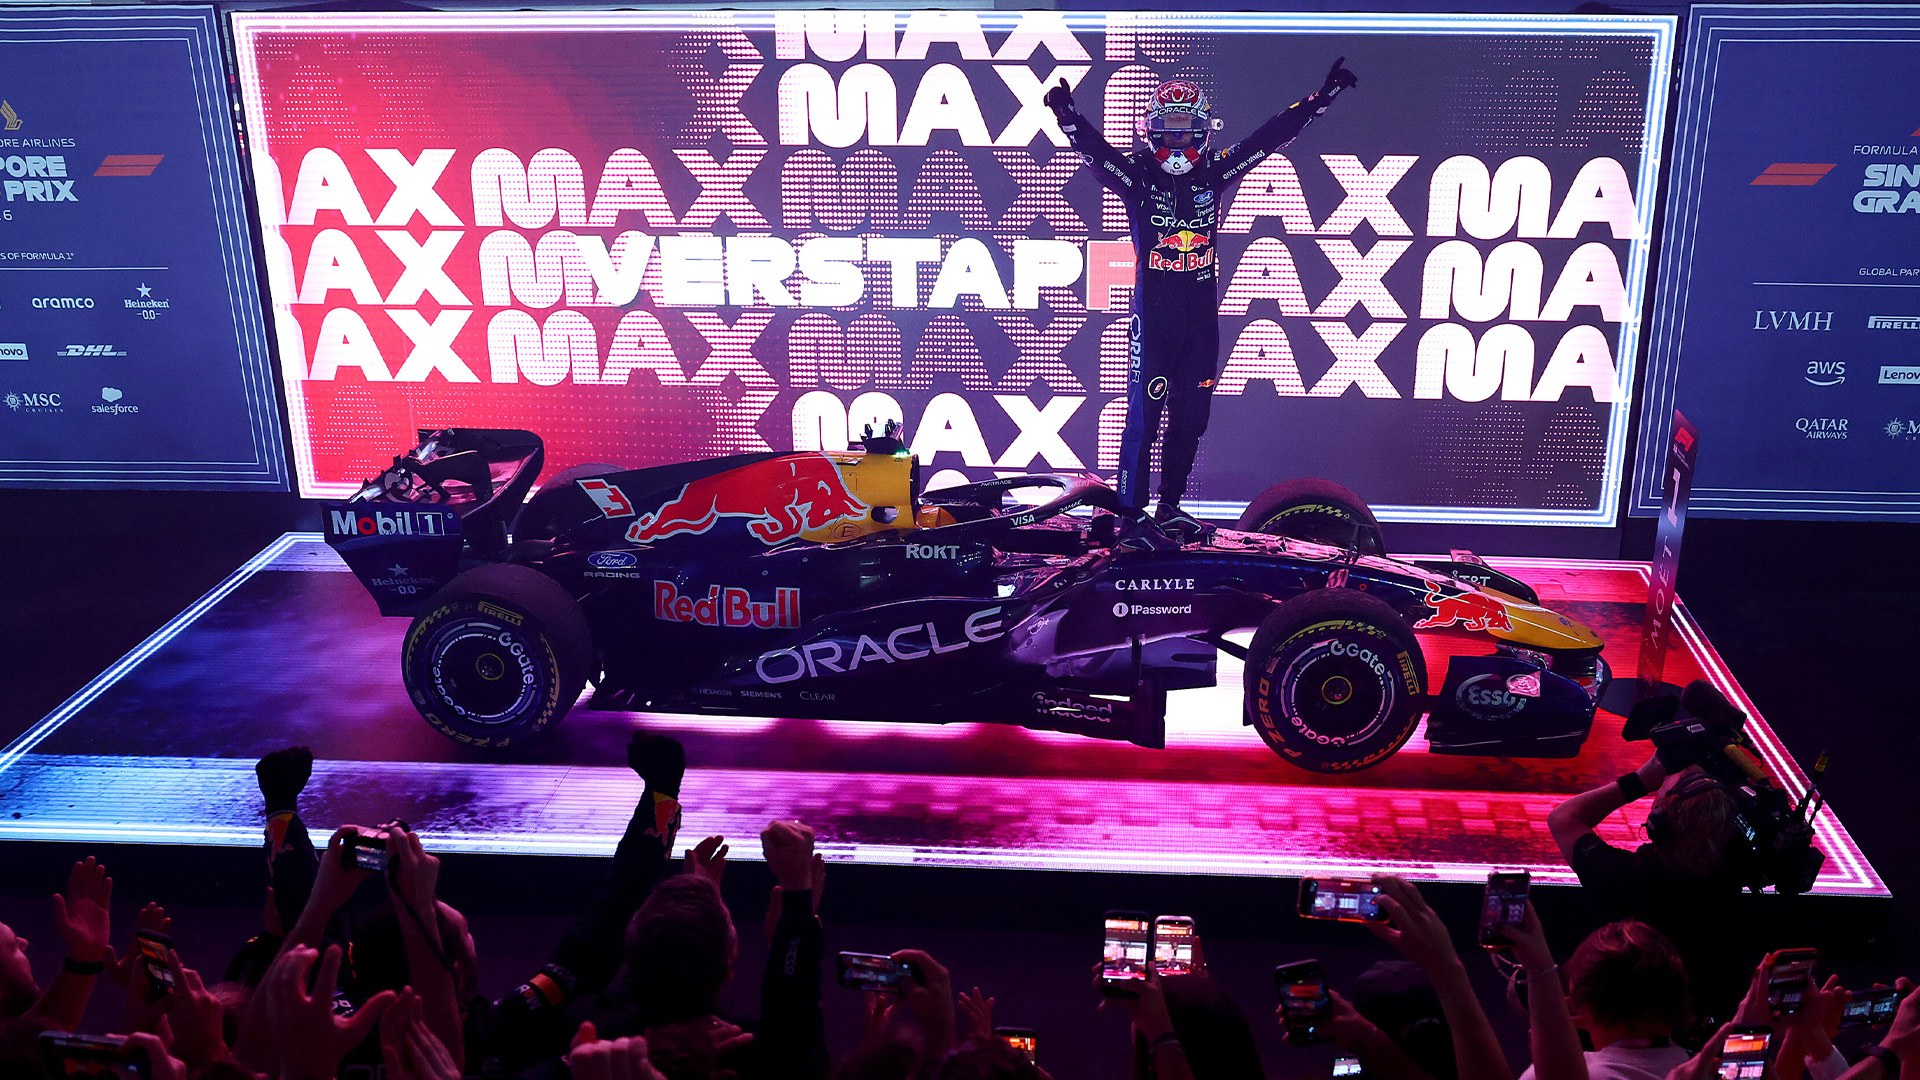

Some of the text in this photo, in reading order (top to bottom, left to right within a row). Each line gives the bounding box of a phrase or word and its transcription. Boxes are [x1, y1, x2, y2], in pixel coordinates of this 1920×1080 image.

[778, 62, 1092, 148] MAX
[1159, 107, 1197, 115] ORACLE
[23, 139, 75, 147] AIRLINES
[1853, 145, 1918, 155] FORMULA
[4, 180, 79, 201] PRIX
[270, 147, 465, 227] AX
[471, 147, 771, 229] MAX
[780, 148, 1090, 232] MAX
[1151, 213, 1215, 229] ORACLE
[1149, 247, 1214, 272] Red Bull
[276, 229, 475, 306] AX
[1216, 237, 1414, 319] AX
[1859, 268, 1898, 276] GLOBAL
[32, 298, 95, 309] aramco
[124, 299, 169, 308] Heineken
[1753, 310, 1834, 331] LVMH
[1868, 316, 1920, 329] PIRELL
[65, 345, 118, 356] DHL
[286, 307, 482, 383] AX
[487, 309, 779, 386] MAX
[788, 313, 1087, 392] MAX
[1807, 361, 1846, 375] aws
[22, 393, 61, 407] MSC
[92, 404, 139, 415] salesforce
[1795, 417, 1848, 432] QATAR
[1806, 431, 1847, 440] AIRWAYS
[331, 511, 412, 535] Mobil
[1010, 514, 1035, 526] VISA
[597, 553, 627, 565] Ford
[906, 545, 960, 559] ROKT
[1115, 578, 1195, 591] CARLYLE
[654, 580, 800, 629] Red Bull
[1131, 604, 1192, 616] 1Password
[478, 601, 524, 626] PIRELLI
[756, 606, 1005, 684] ORACLE
[510, 642, 534, 685] Gate
[1346, 643, 1385, 675] Gate
[1397, 651, 1421, 695] PIRELLI
[740, 690, 782, 698] SIEMENS
[800, 691, 835, 701] CLEAR
[1258, 677, 1286, 743] ZERO
[425, 712, 490, 747] ZERO
